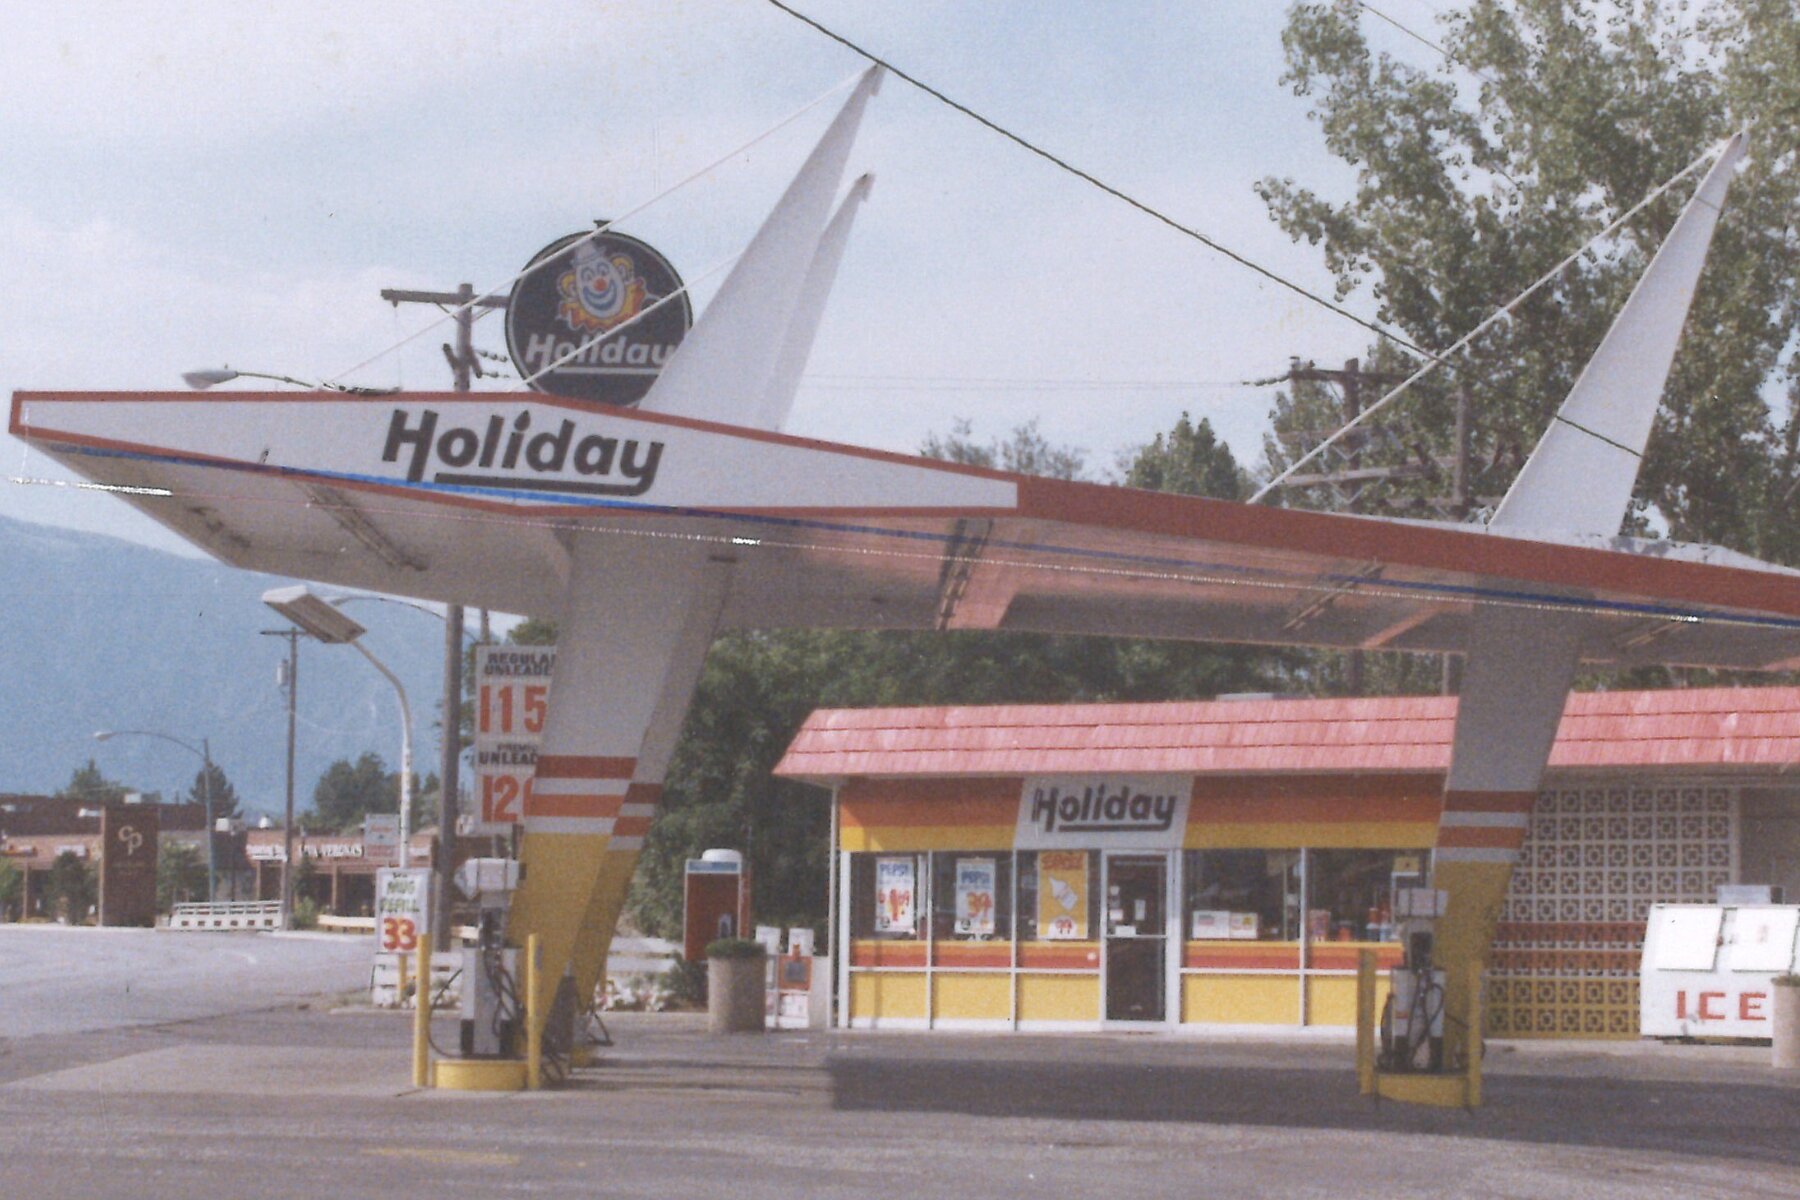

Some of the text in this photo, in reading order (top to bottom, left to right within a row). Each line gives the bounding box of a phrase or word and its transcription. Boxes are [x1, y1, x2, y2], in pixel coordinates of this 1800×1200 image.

[525, 333, 677, 374] Holiday
[382, 409, 664, 497] Holiday
[480, 685, 548, 734] 115
[1031, 783, 1176, 832] Holiday
[383, 917, 417, 951] 33
[1676, 990, 1767, 1021] ICE
